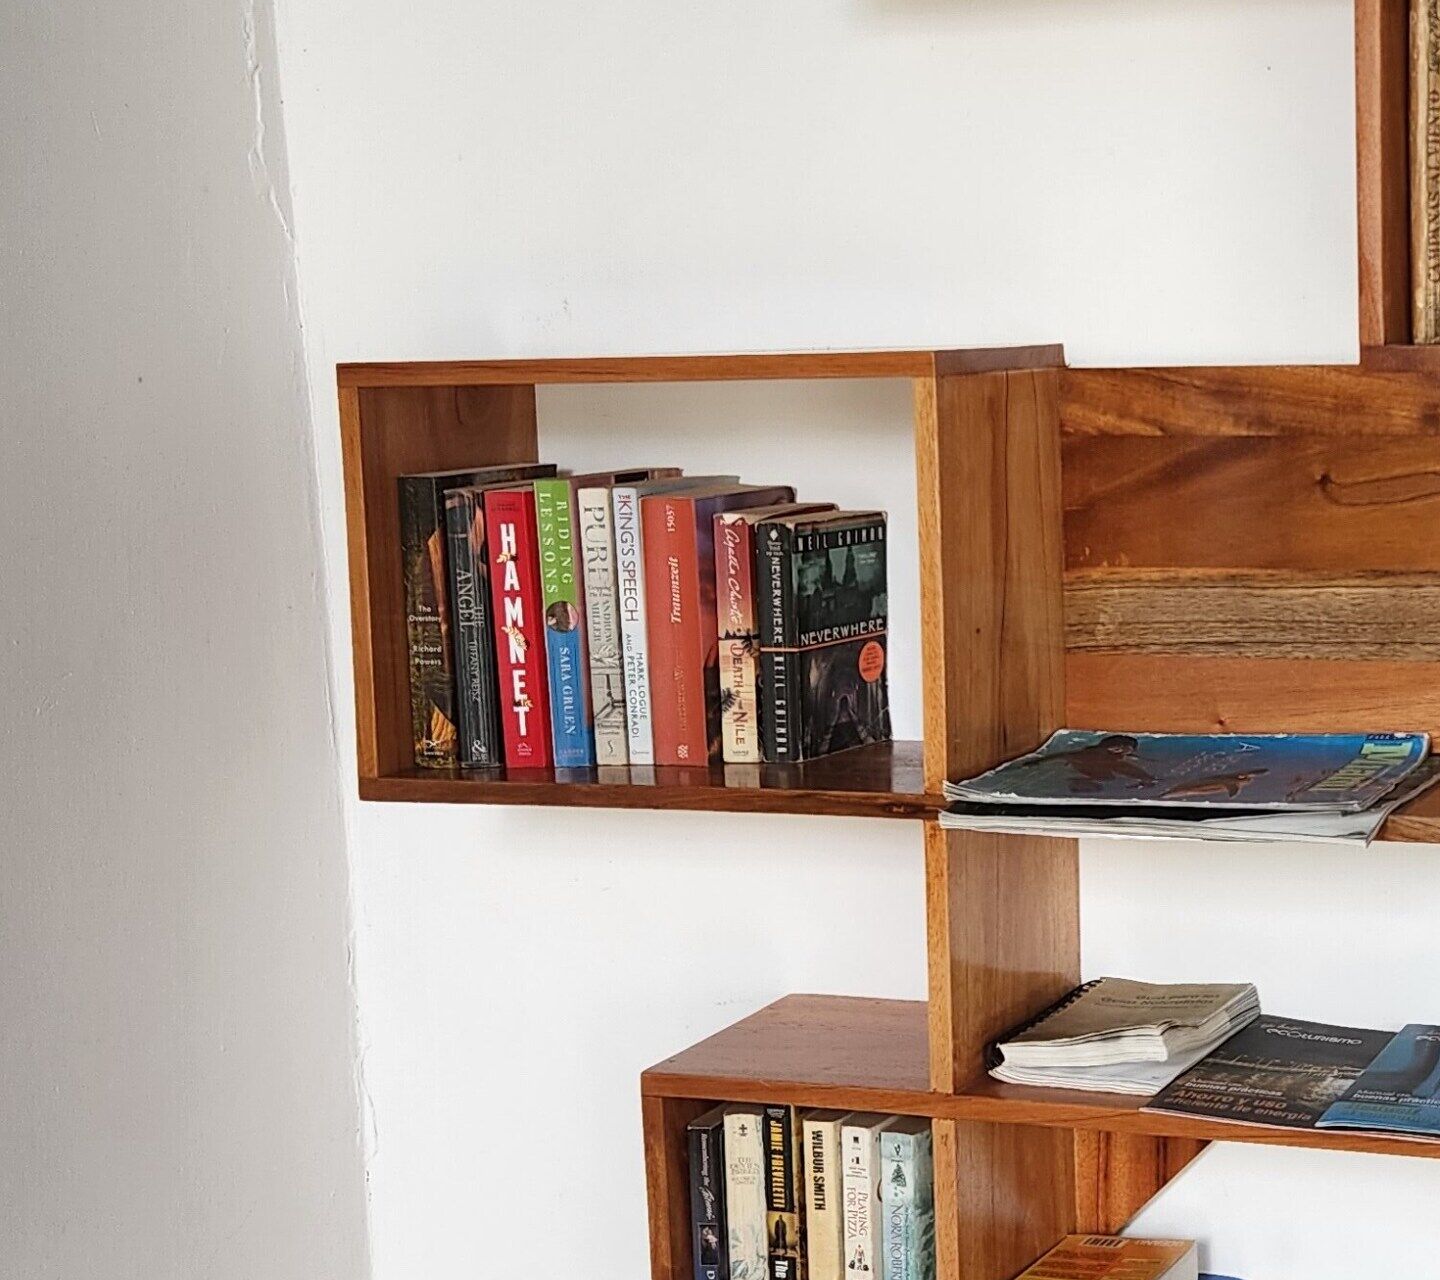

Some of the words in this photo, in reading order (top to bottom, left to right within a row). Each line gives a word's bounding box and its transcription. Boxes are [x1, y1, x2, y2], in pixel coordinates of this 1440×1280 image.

[1427, 90, 1440, 153] VIENTO
[1427, 190, 1440, 283] CAMPANAS
[539, 492, 558, 595] LESSONS
[556, 500, 573, 586] RIDING
[583, 505, 609, 584] PURE
[618, 500, 636, 556] KING'S
[724, 528, 740, 576] Agatha
[456, 568, 476, 634] ANGEL
[621, 559, 638, 622] SPEECH
[667, 554, 682, 624] Traumzeit
[770, 555, 785, 644] NEVERWHERE
[408, 614, 442, 624] Overstory
[418, 604, 432, 613] The
[474, 603, 484, 628] THE
[591, 600, 602, 643] MILLER
[602, 598, 613, 644] ANDREW
[500, 522, 531, 737] HAMNET
[625, 633, 635, 652] AND
[800, 618, 885, 646] NEVERWHERE
[413, 645, 442, 654] Richard
[414, 657, 442, 666] Powers
[468, 639, 480, 677] TIFFANY
[559, 646, 571, 681] SARA
[636, 651, 645, 680] MARK
[728, 642, 744, 690] DEATH
[627, 655, 637, 687] PETER
[774, 654, 785, 689] NEIL
[561, 684, 578, 736] GRUEN
[629, 690, 640, 739] CONRADI
[638, 685, 647, 720] LOGUE
[732, 711, 749, 745] NILE
[1266, 1027, 1363, 1045] ecoturismo
[1172, 1089, 1234, 1102] Ahorro
[1254, 1100, 1288, 1109] uso
[1184, 1081, 1226, 1092] buenas
[1227, 1085, 1283, 1097] prácticas
[1352, 1093, 1396, 1103] buenas
[1232, 1104, 1251, 1112] de
[770, 1120, 784, 1151] JAMIE
[811, 1130, 825, 1174] WILBUR
[772, 1154, 785, 1208] FREVELETTI
[813, 1175, 826, 1211] SMITH
[847, 1186, 857, 1208] FOR
[848, 1209, 859, 1240] PIZZA
[857, 1192, 869, 1236] PLAYING
[889, 1203, 904, 1241] NORA
[775, 1260, 788, 1278] The
